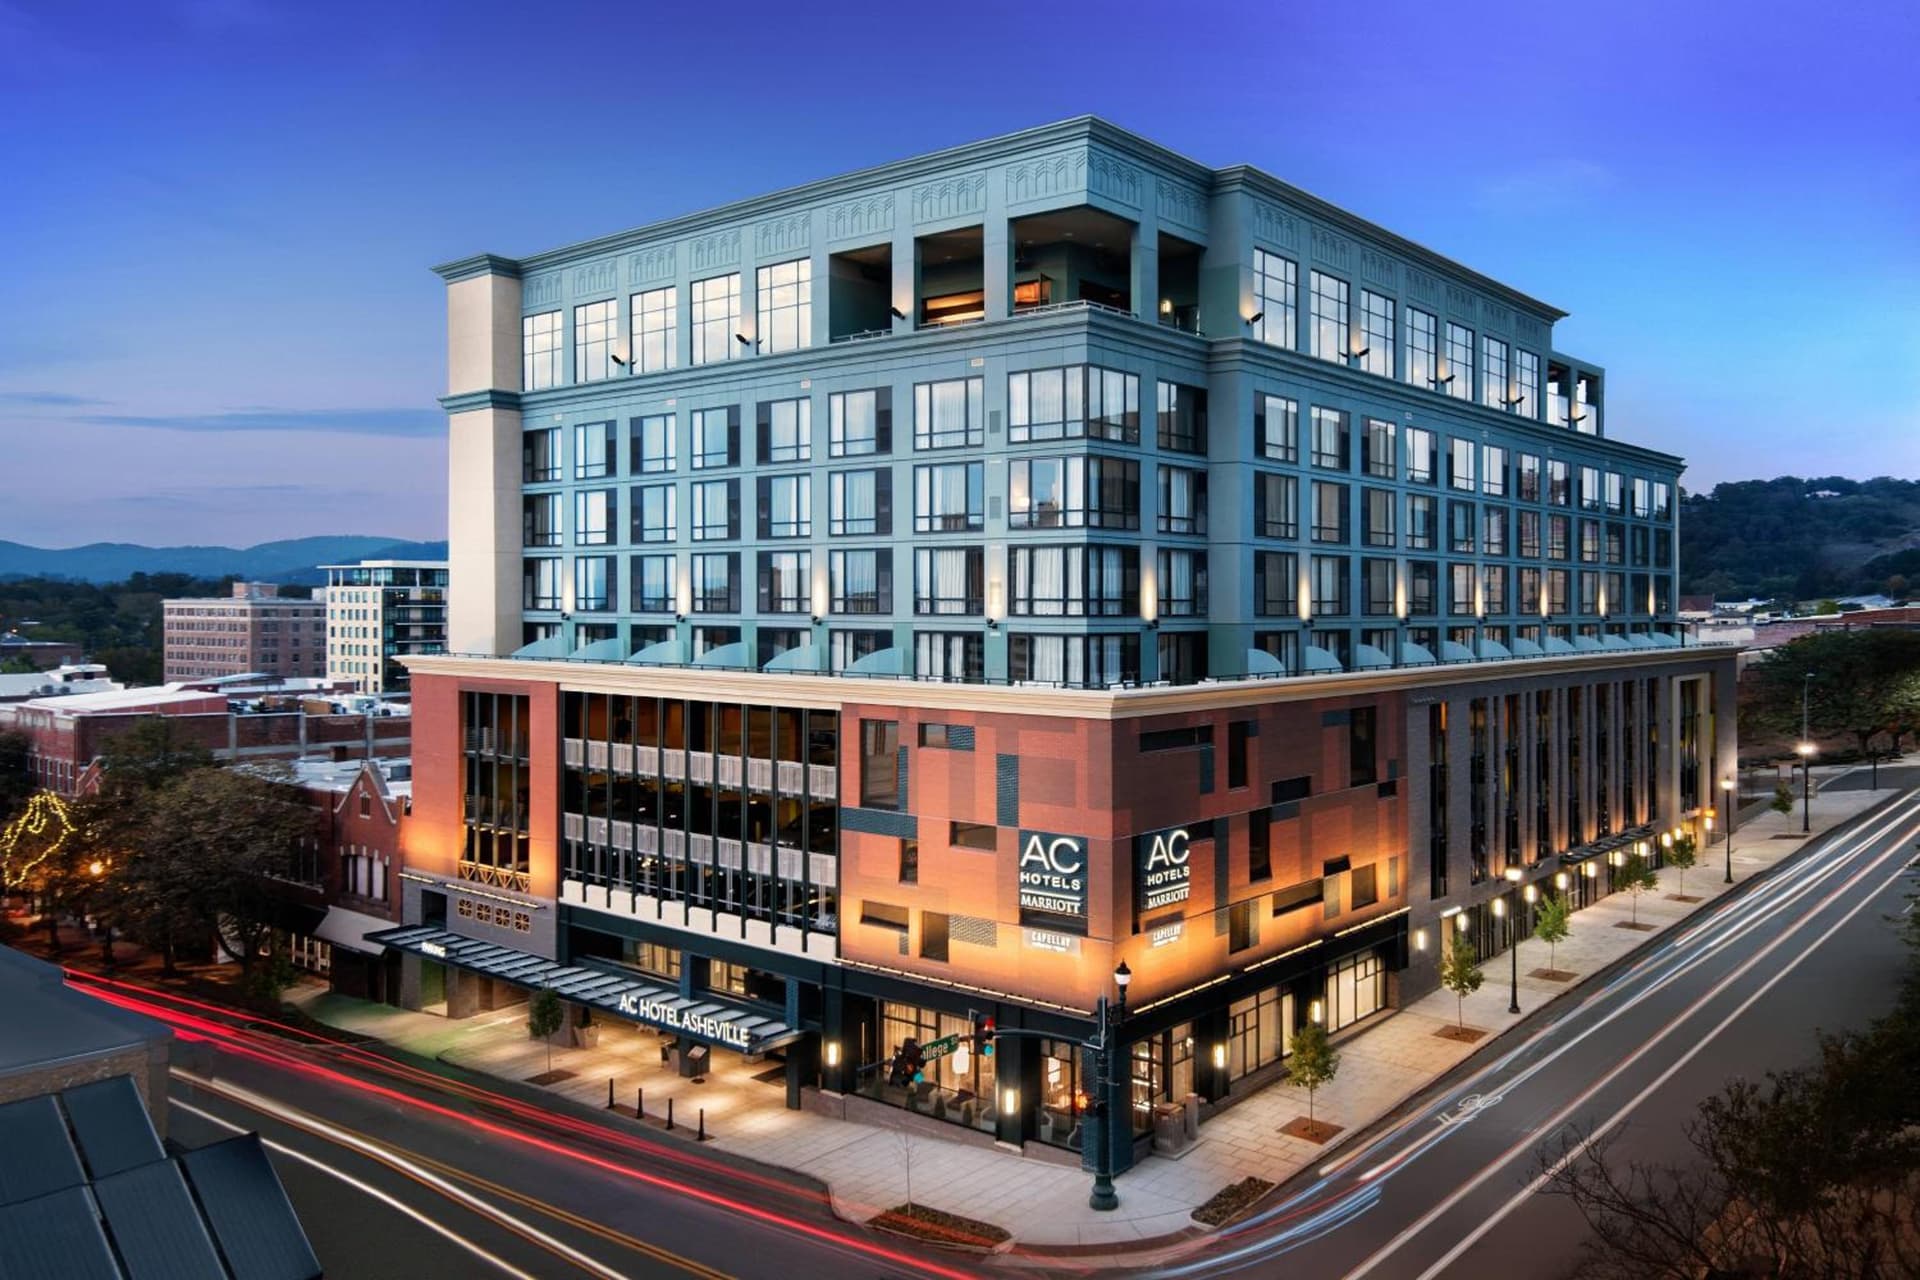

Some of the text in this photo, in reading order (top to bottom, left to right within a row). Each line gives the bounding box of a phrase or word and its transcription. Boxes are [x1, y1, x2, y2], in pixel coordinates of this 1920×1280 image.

[1020, 835, 1080, 874] AC
[1147, 829, 1190, 871] AC
[1020, 871, 1081, 891] HOTELS
[1147, 865, 1190, 887] HOTELS
[1020, 893, 1080, 914] MARRIOTT
[1147, 887, 1190, 910] MARRIOTT
[619, 993, 751, 1048] AC HOTEL ASHEVILLE
[920, 1042, 949, 1061] ollege
